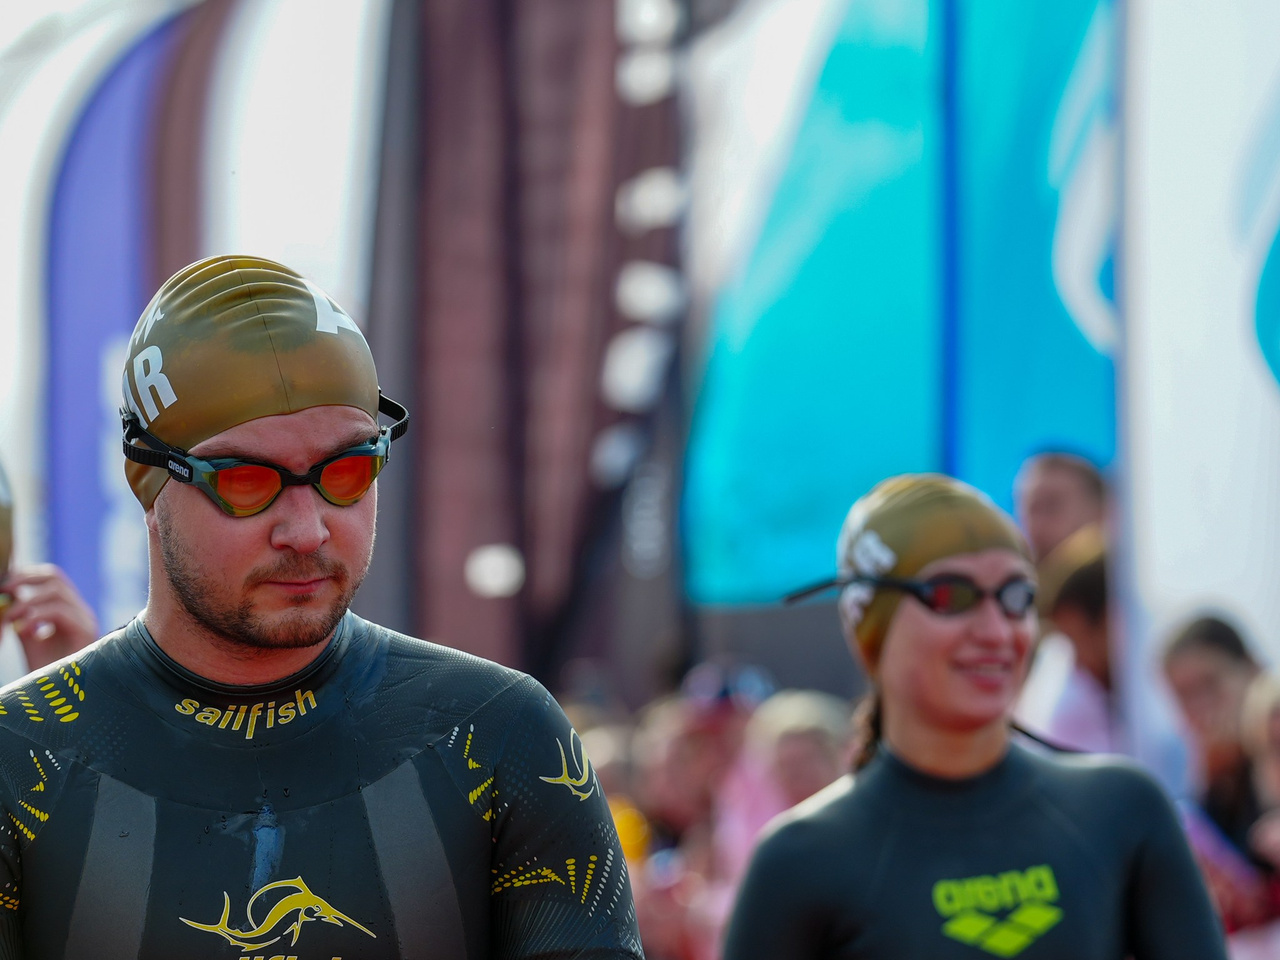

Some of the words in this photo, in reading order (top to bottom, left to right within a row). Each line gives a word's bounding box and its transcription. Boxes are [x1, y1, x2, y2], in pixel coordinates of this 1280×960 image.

[168, 459, 190, 478] arena
[174, 688, 318, 740] sailfish
[931, 863, 1061, 920] arena
